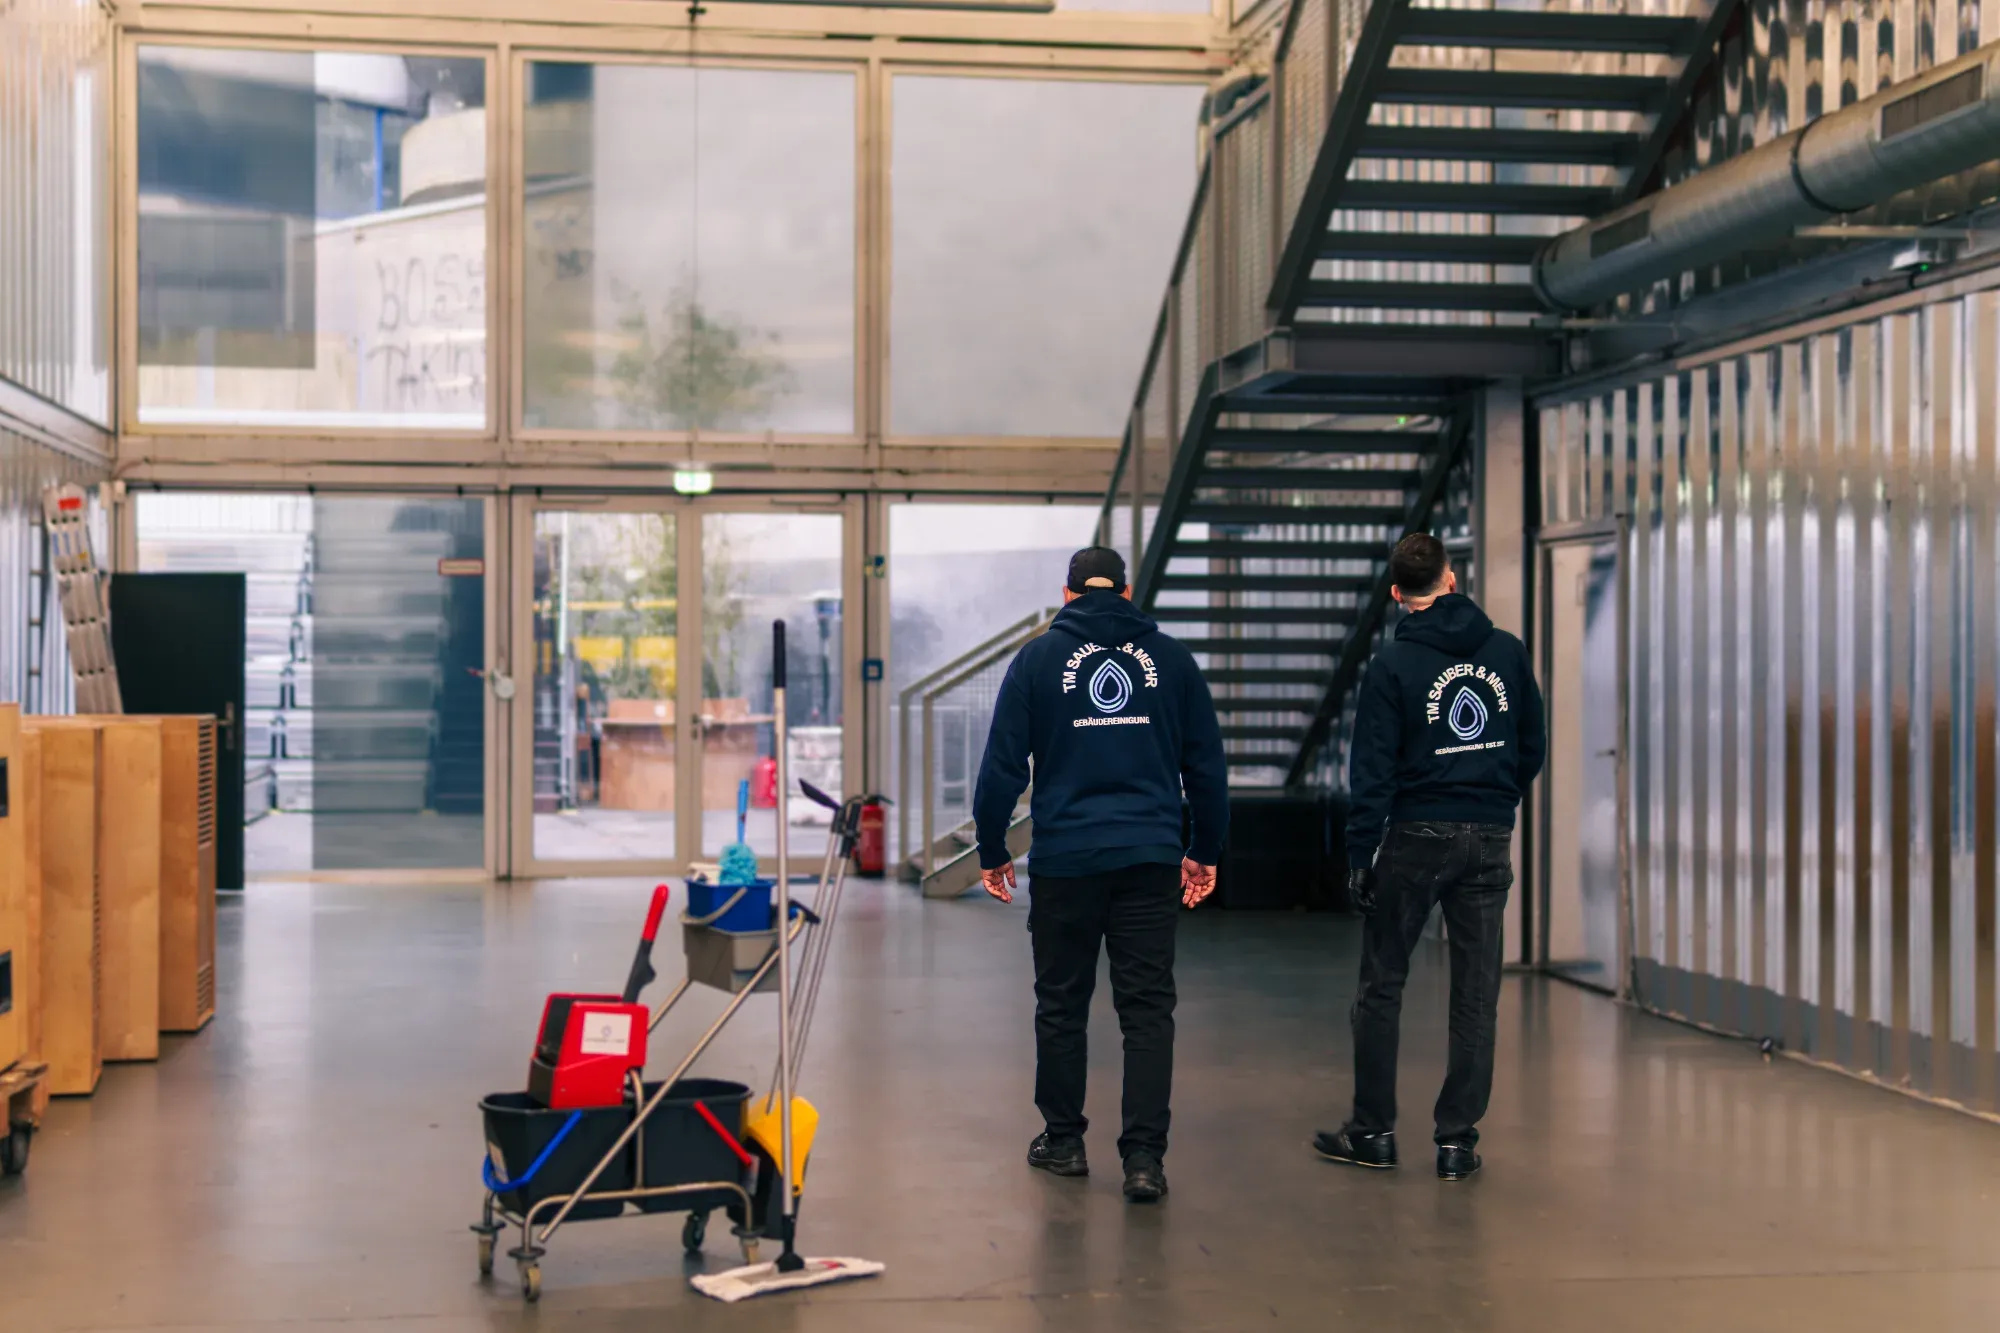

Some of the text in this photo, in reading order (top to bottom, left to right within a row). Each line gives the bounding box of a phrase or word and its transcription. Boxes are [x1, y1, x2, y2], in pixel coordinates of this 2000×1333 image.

[1063, 642, 1158, 694] TM SAUB & MEHR
[1426, 664, 1509, 725] TM SAUBER & MEHR
[1073, 716, 1150, 728] GEBÄUDEREINIGUNG
